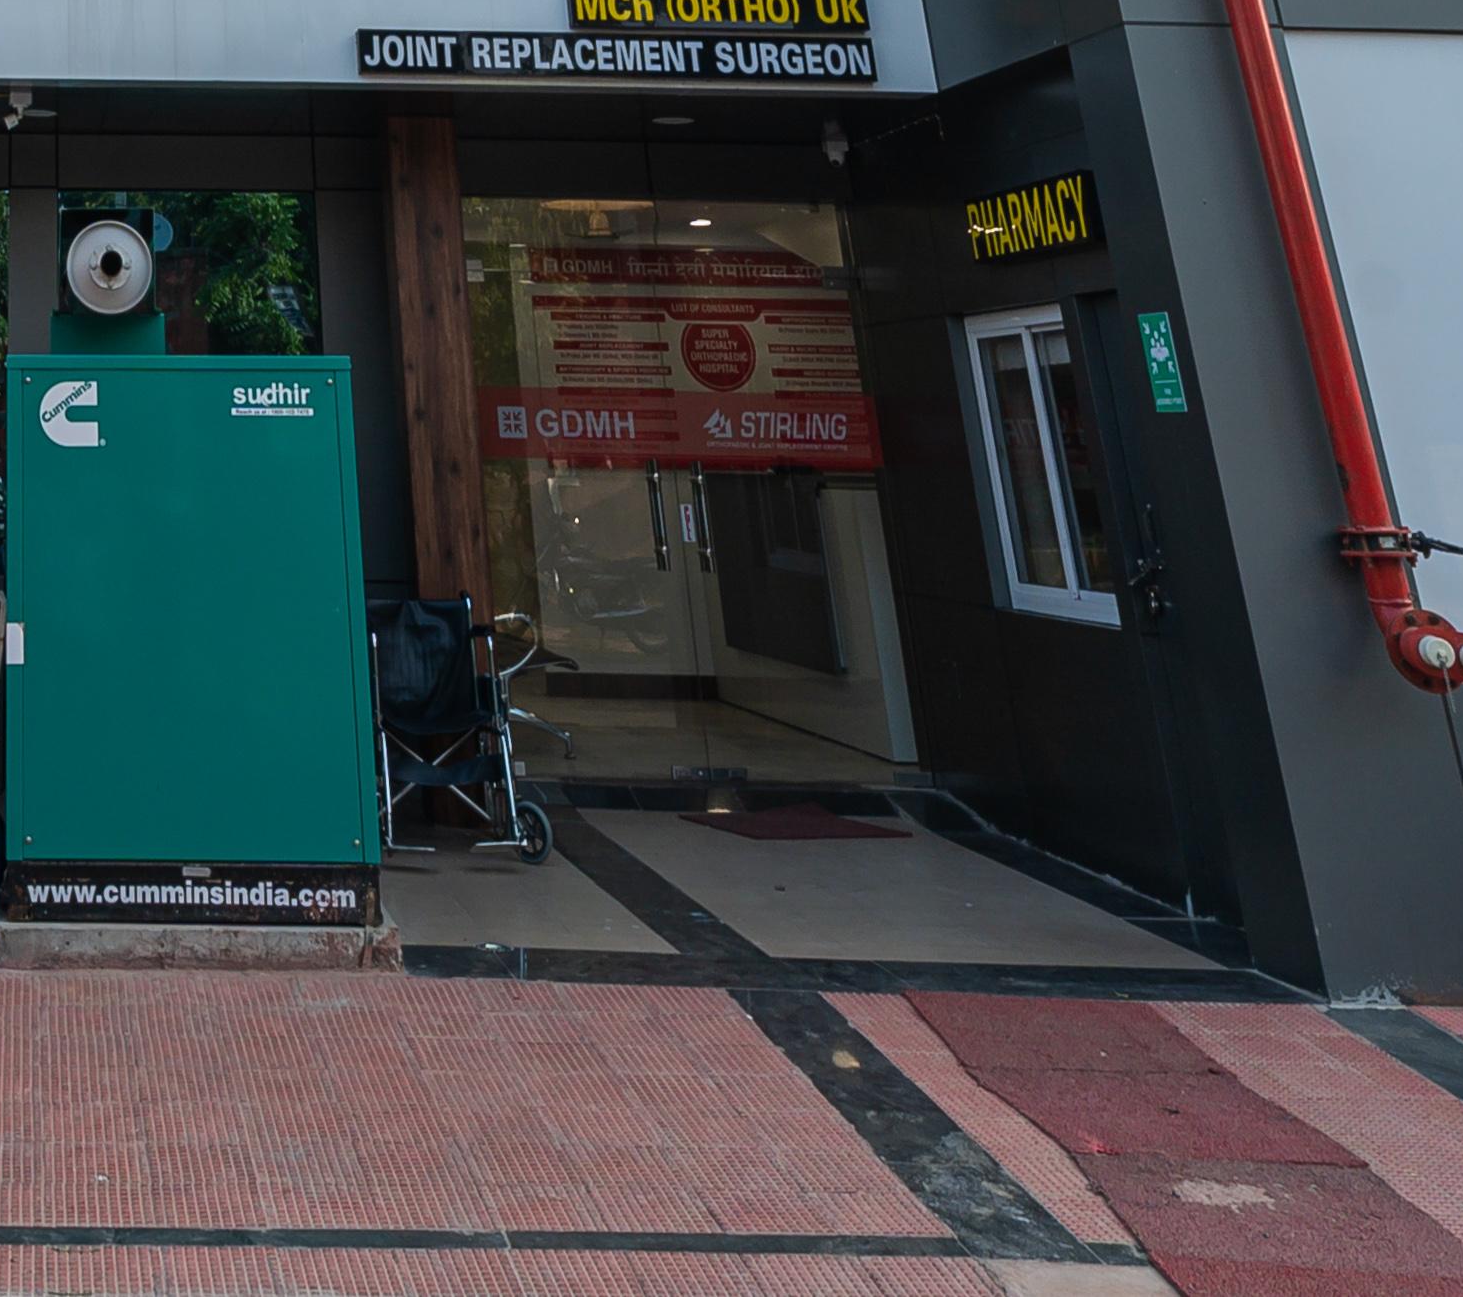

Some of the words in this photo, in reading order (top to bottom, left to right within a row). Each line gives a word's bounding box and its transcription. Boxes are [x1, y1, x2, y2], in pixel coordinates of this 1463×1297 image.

[365, 35, 457, 68] JOINT
[472, 37, 703, 73] REPLACEMENT
[715, 42, 871, 76] SURGEON
[967, 175, 1087, 259] PHARMACY
[563, 259, 613, 274] GDMH
[701, 328, 729, 338] SUPER
[699, 363, 739, 373] HOSPITAL
[42, 382, 92, 422] Cummins
[233, 382, 310, 406] sudhir
[535, 408, 636, 439] GDMH
[741, 411, 847, 440] STIRLING
[27, 880, 356, 908] www.cumminsindia.com
